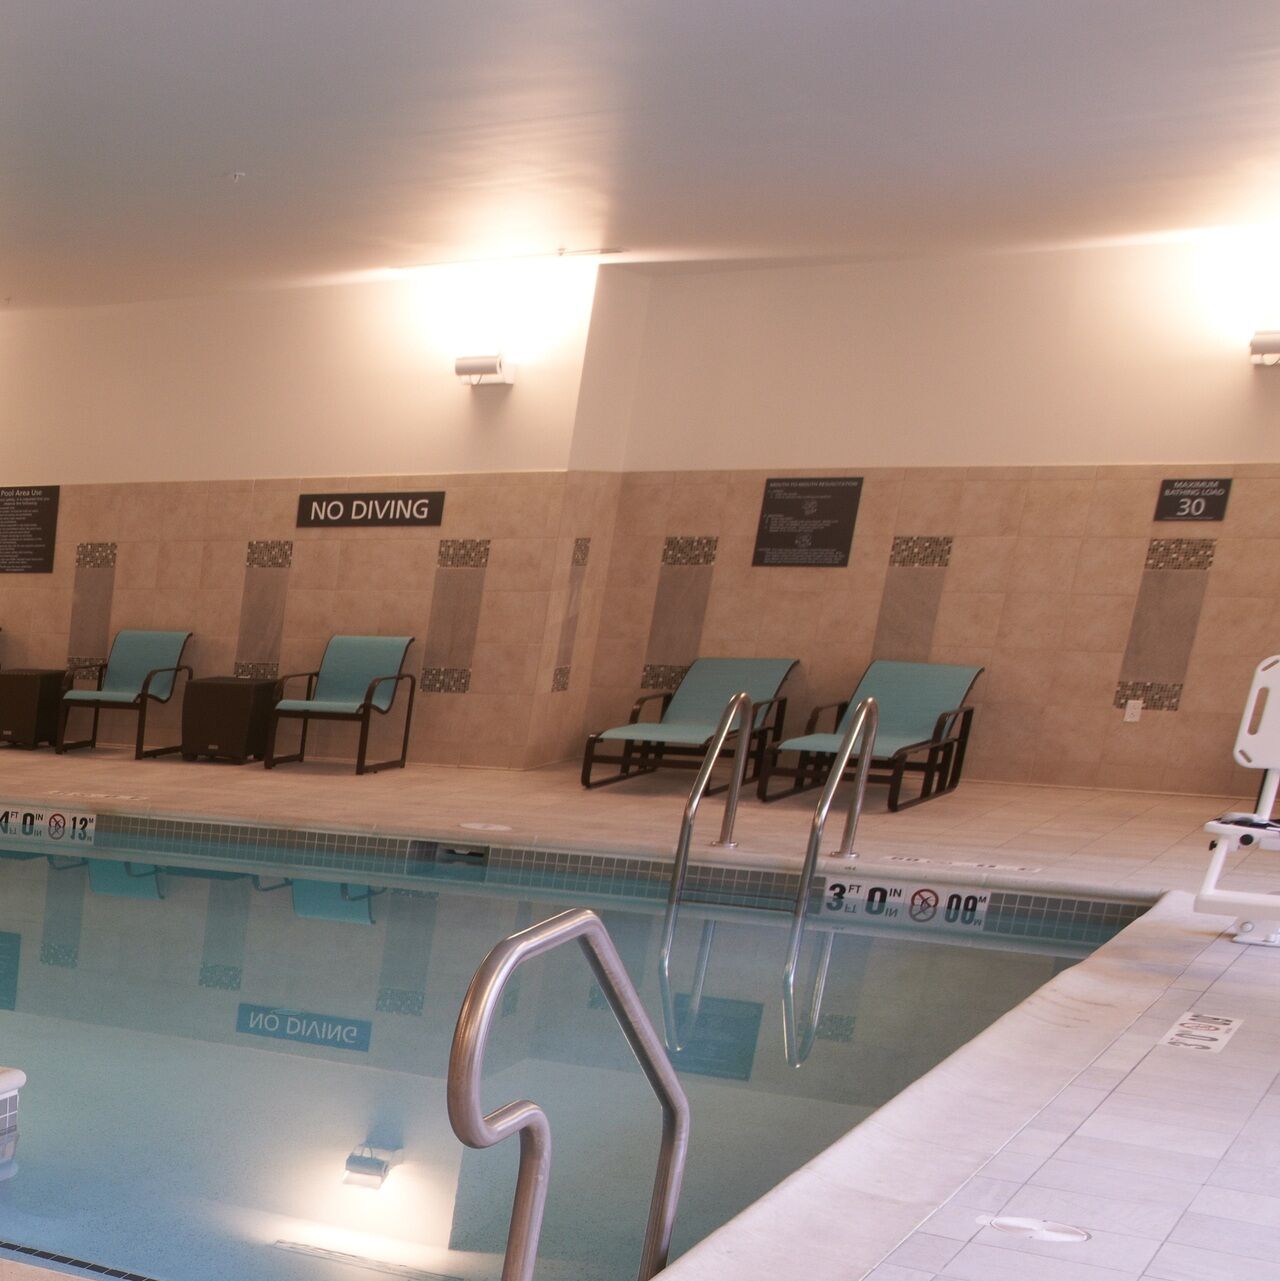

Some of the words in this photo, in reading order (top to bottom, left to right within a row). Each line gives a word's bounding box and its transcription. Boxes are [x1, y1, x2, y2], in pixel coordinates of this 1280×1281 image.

[311, 501, 344, 520] NO
[351, 499, 429, 520] DIVING
[1176, 498, 1206, 516] 30
[10, 811, 19, 819] FT
[21, 813, 35, 835] 0
[35, 813, 44, 822] IN
[826, 883, 846, 911] 3
[848, 884, 862, 895] FT
[865, 886, 888, 915] 0
[889, 887, 902, 898] IN
